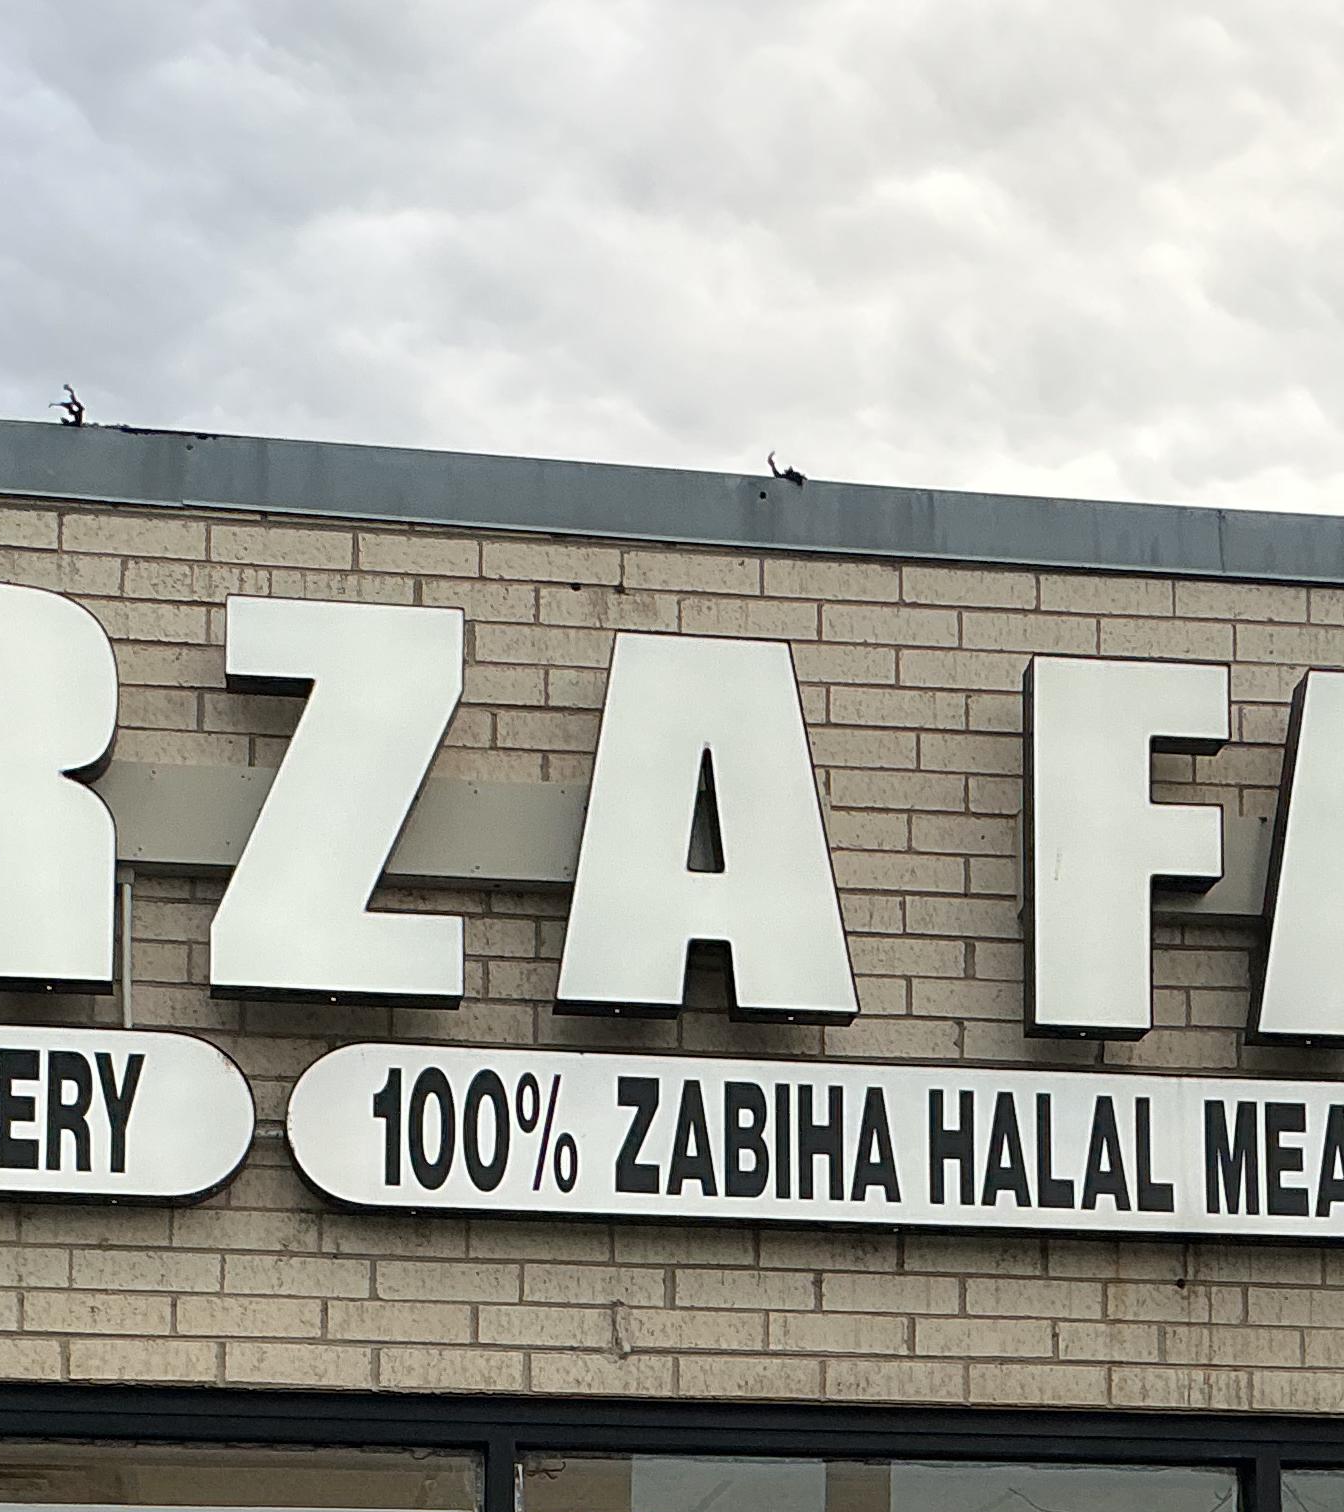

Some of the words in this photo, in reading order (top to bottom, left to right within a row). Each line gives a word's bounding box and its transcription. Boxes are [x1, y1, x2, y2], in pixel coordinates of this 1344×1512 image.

[372, 1066, 578, 1195] 100%
[613, 1076, 902, 1205] ZABIHA
[926, 1088, 1174, 1214] HALAL
